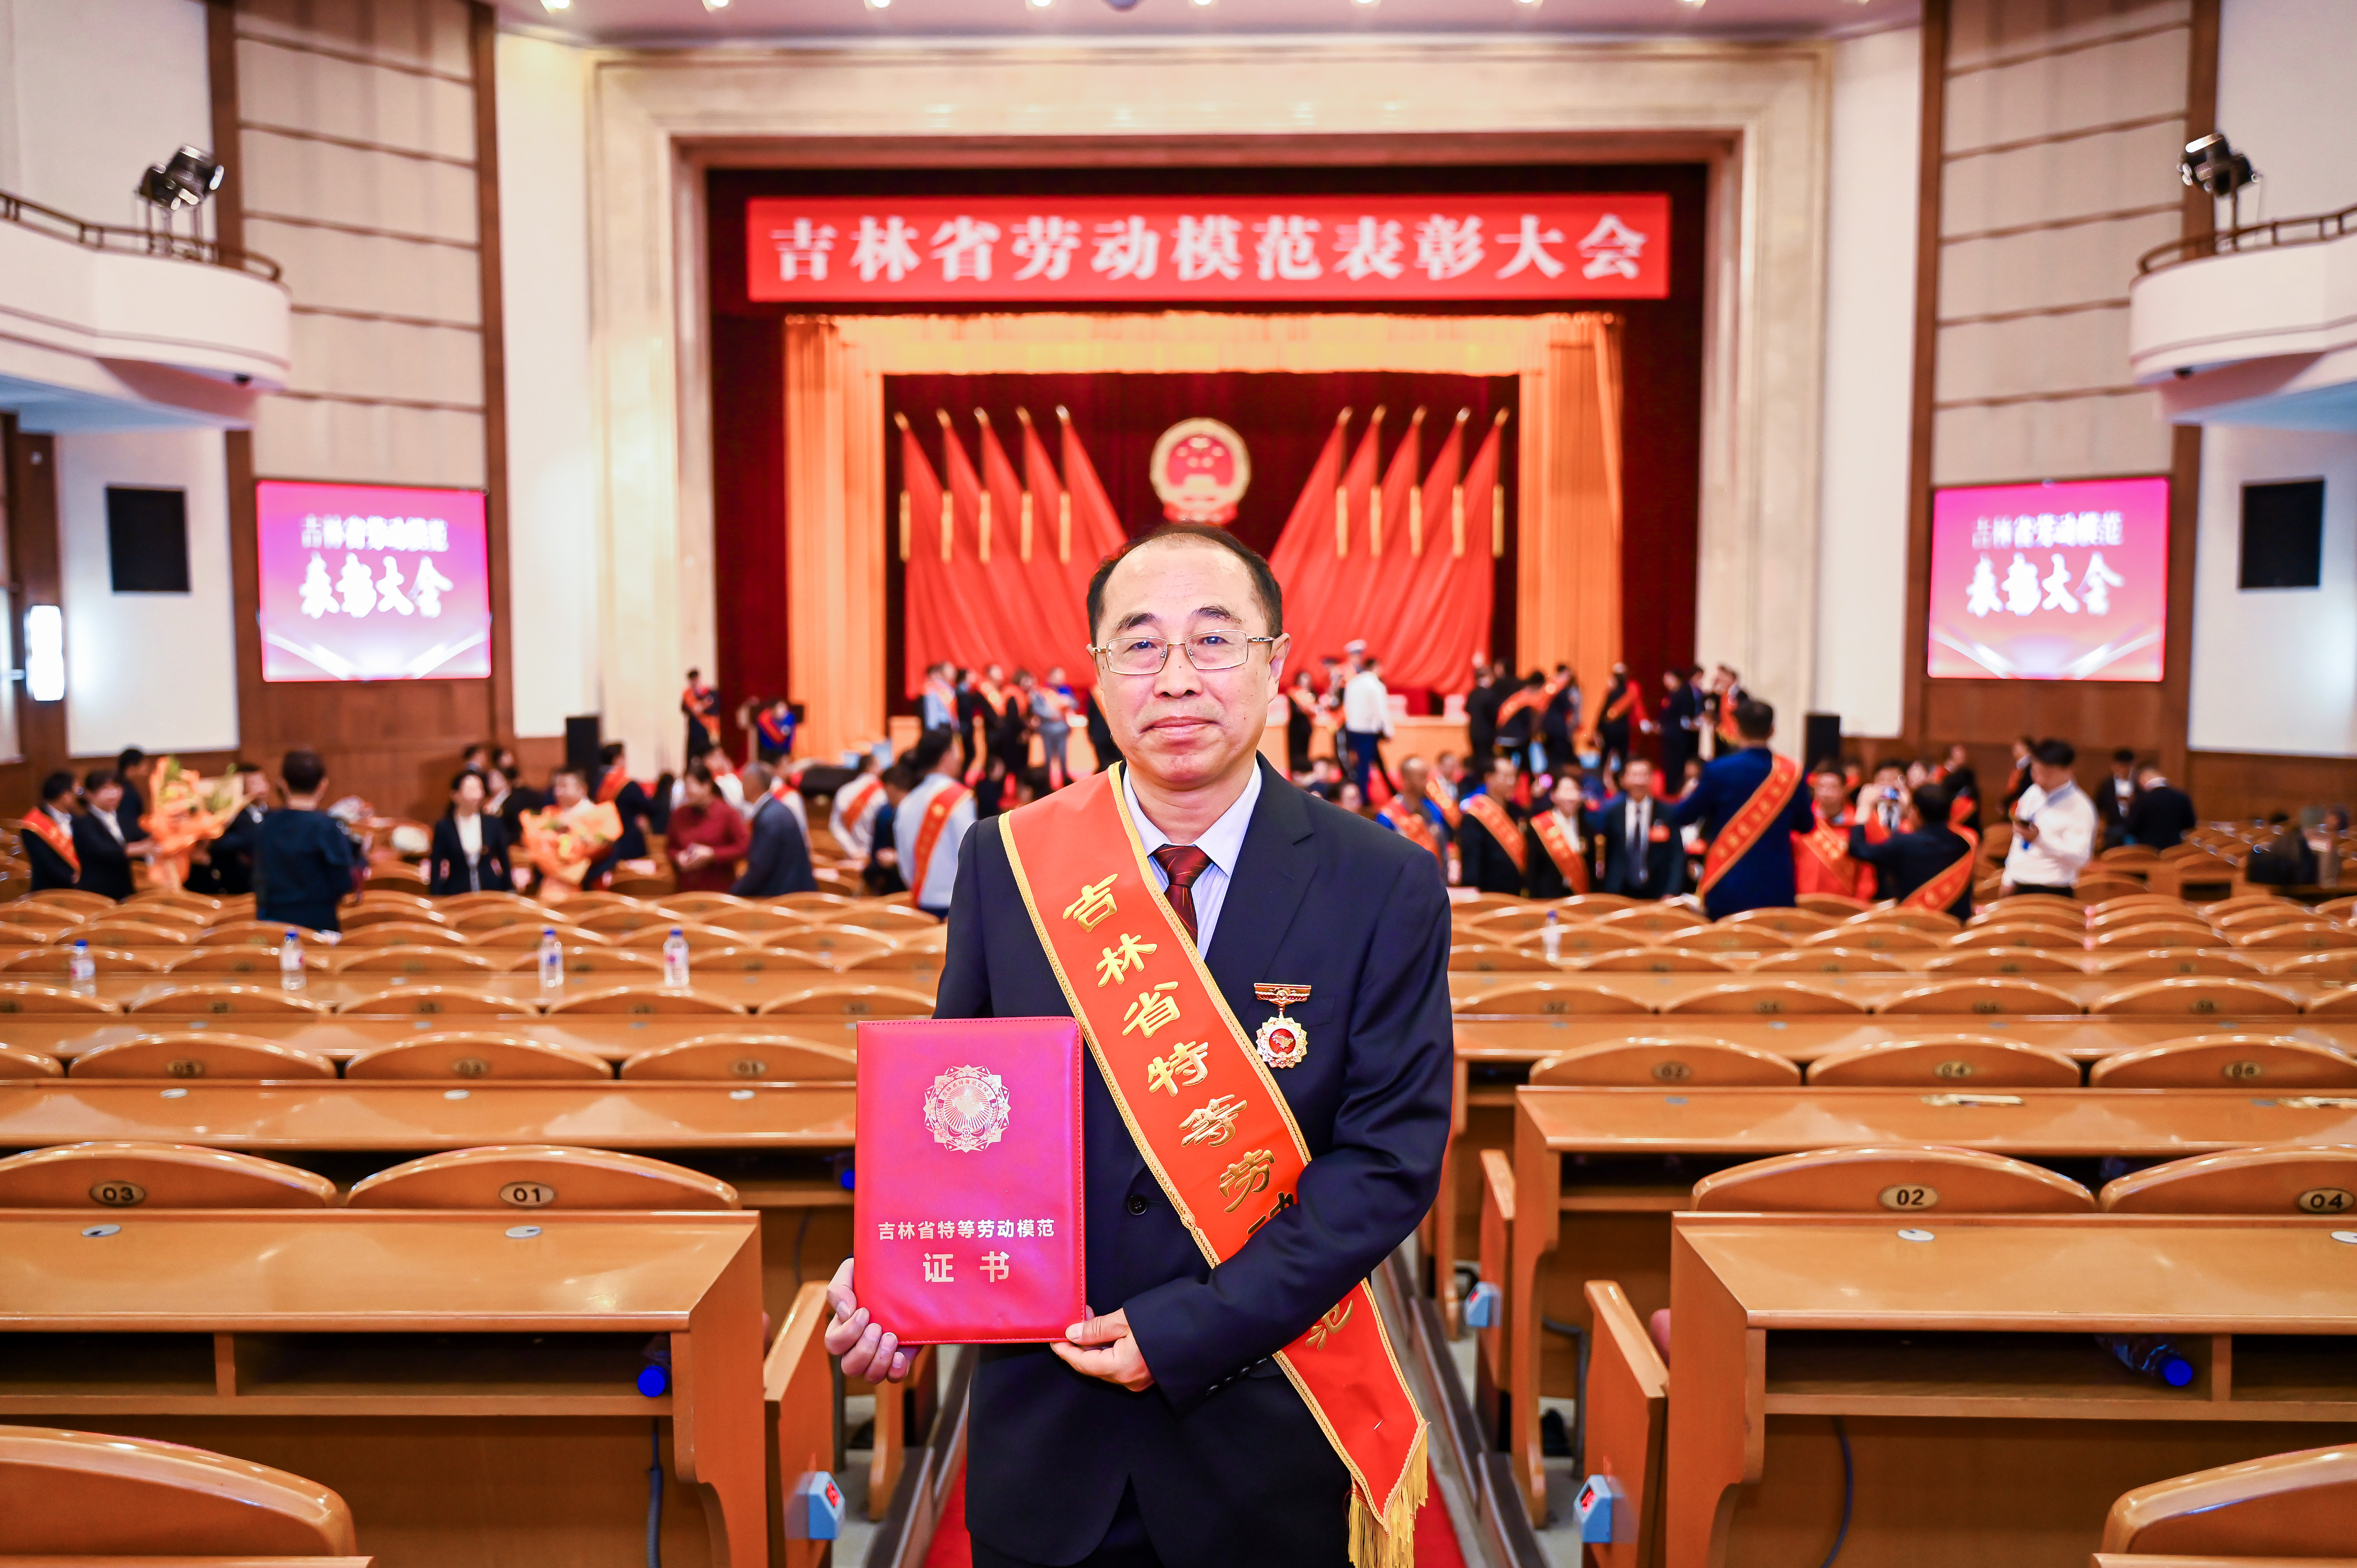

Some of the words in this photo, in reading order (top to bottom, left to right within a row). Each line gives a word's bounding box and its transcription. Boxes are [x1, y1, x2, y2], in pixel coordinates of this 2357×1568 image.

[771, 214, 1647, 282] 吉林省劳动模范表彰大会
[1942, 1063, 1965, 1078] 04
[103, 1187, 134, 1201] 03
[513, 1188, 541, 1202] 01
[1897, 1189, 1924, 1205] 02
[2310, 1194, 2343, 1209] 04
[878, 1218, 1055, 1240] 吉林省特等劳动模范
[922, 1251, 1010, 1282] 证书
